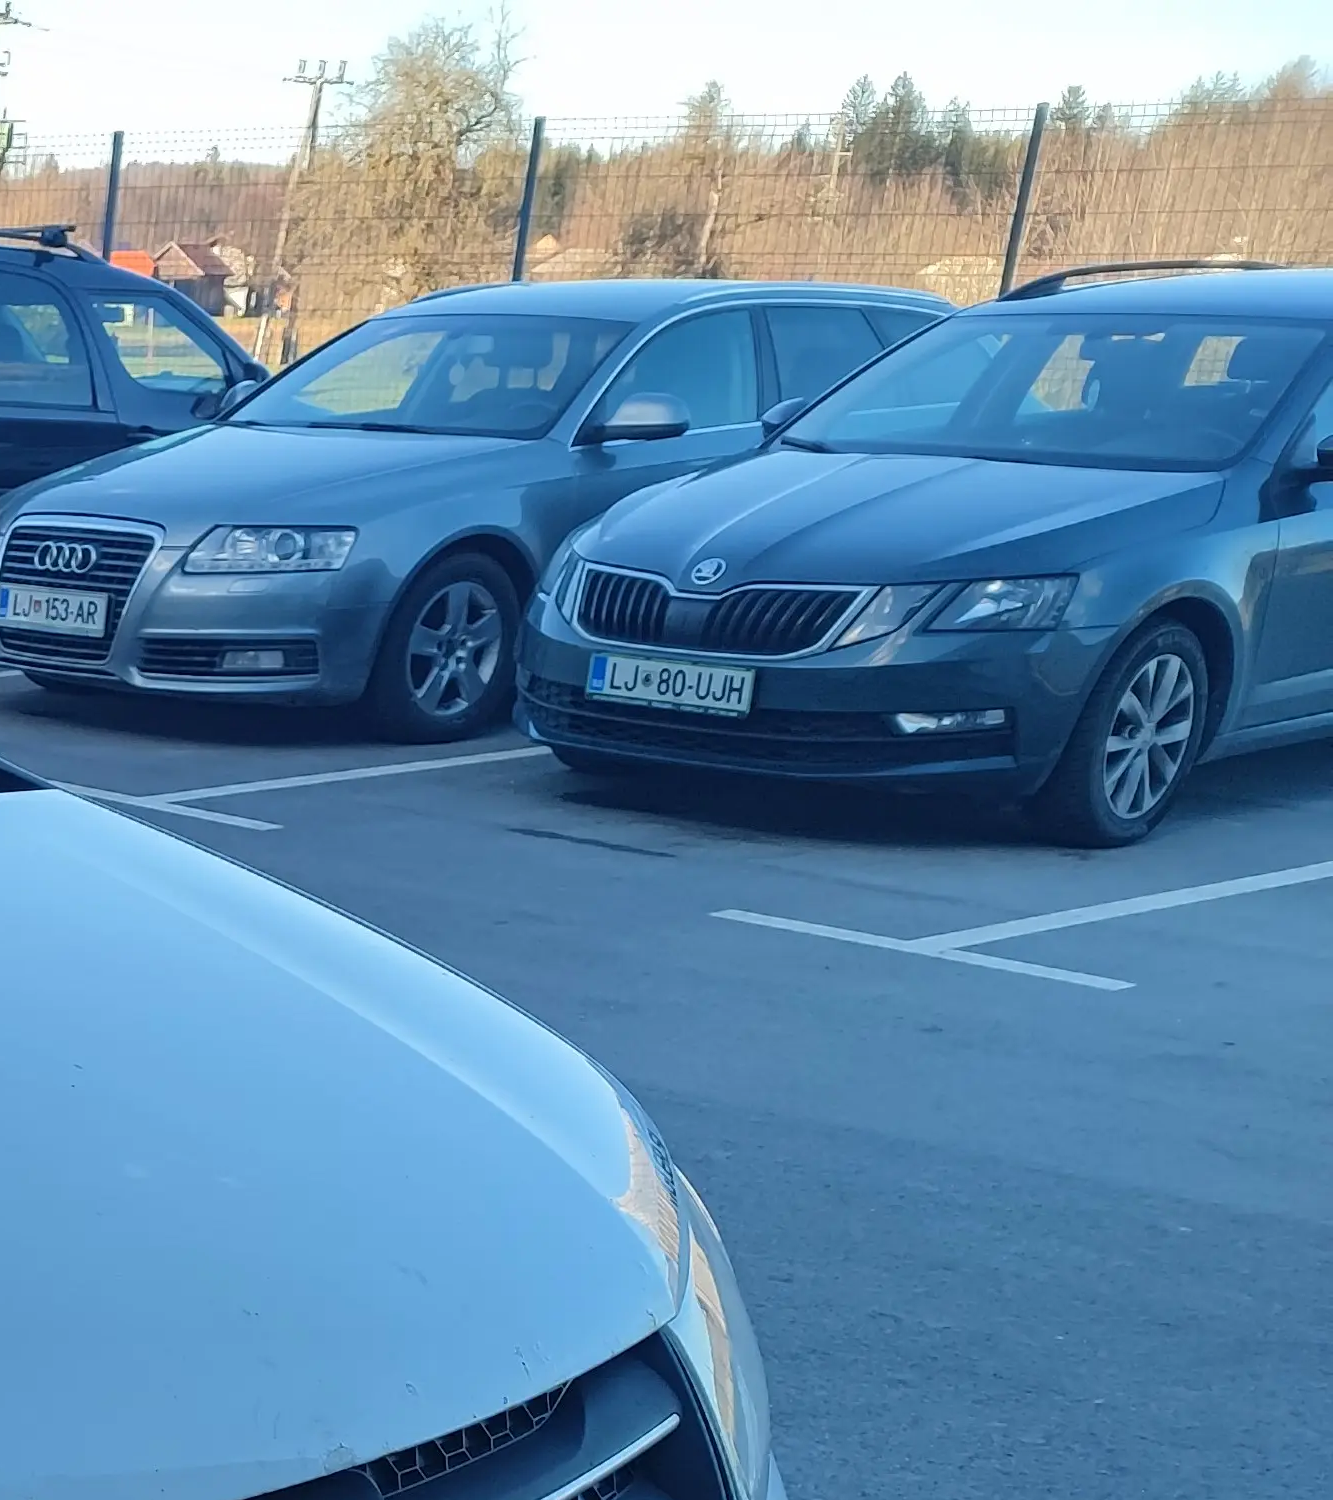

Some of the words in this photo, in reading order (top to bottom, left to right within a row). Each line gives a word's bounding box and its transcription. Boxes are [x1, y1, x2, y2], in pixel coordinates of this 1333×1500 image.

[13, 593, 33, 617] LJ
[45, 597, 98, 624] 153-AR
[609, 662, 640, 692] LJ
[657, 667, 746, 705] 80-UJH
